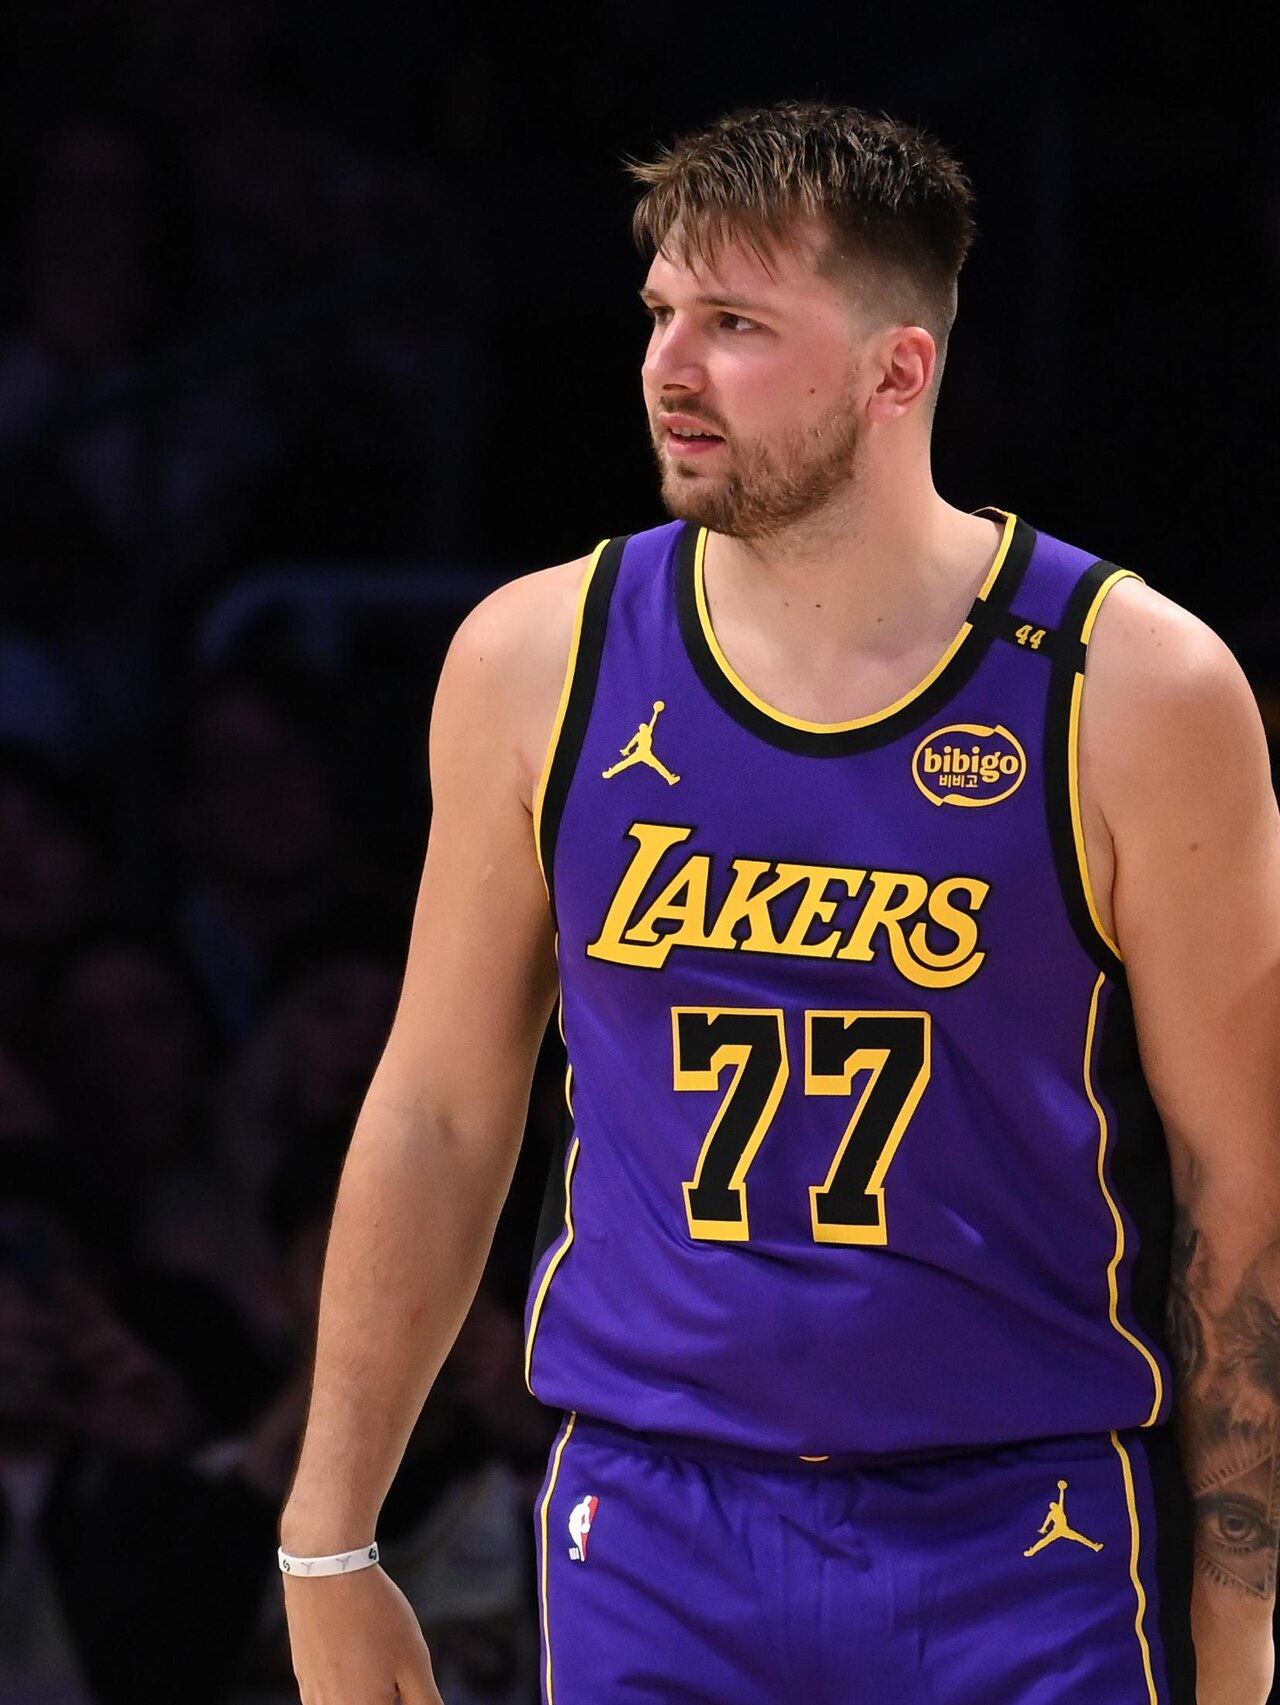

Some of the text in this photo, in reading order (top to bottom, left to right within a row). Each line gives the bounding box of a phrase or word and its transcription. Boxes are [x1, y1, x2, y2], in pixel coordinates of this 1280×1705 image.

[1015, 624, 1046, 650] 44
[923, 745, 1019, 783] bibigo
[938, 774, 979, 788] 비비고
[586, 822, 991, 989] LAKERS
[670, 1006, 932, 1246] 77
